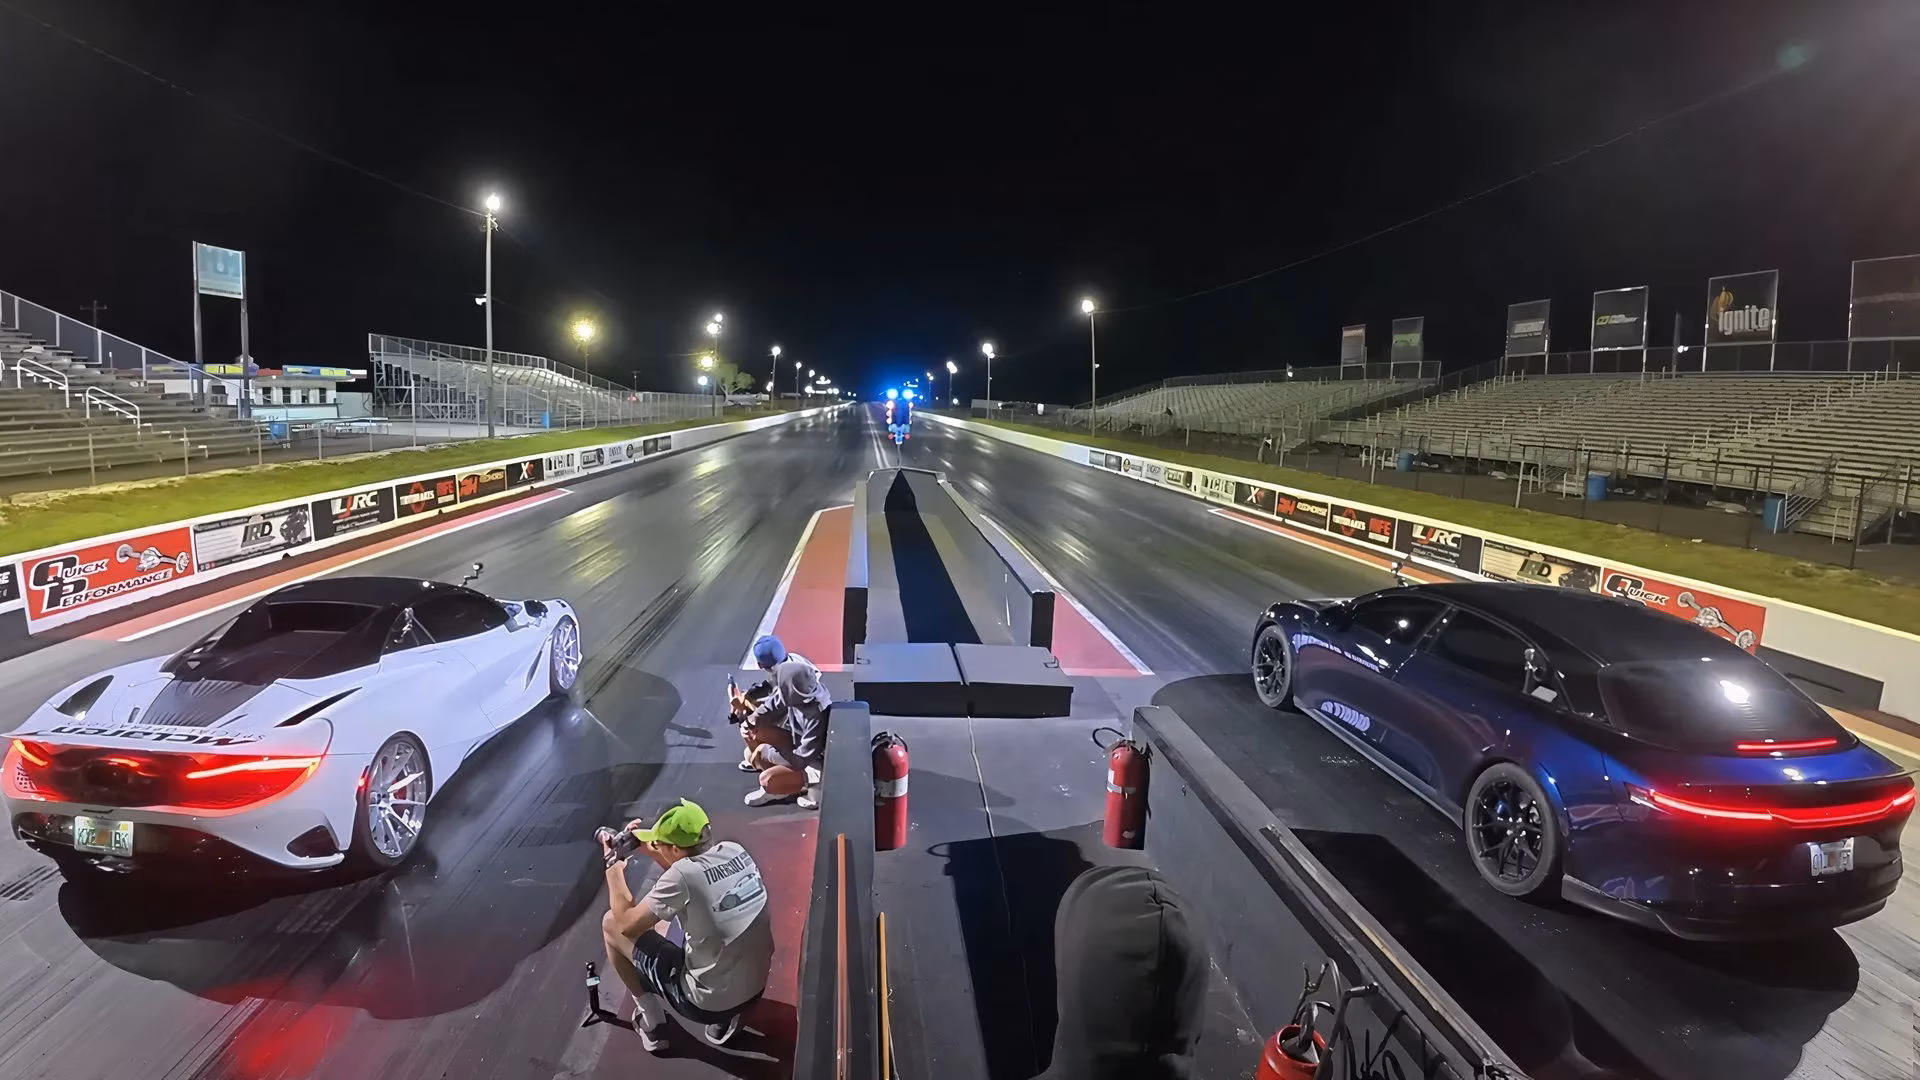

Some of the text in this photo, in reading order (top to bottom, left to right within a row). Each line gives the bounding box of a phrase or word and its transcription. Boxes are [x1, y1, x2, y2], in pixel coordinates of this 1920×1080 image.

[1718, 304, 1770, 335] ignite
[331, 490, 378, 519] LJRC
[1412, 524, 1461, 548] LJRC
[30, 555, 108, 589] QUICK
[41, 568, 173, 613] PERFORMANCE
[1604, 574, 1670, 606] QUICK
[51, 726, 258, 746] McLaren
